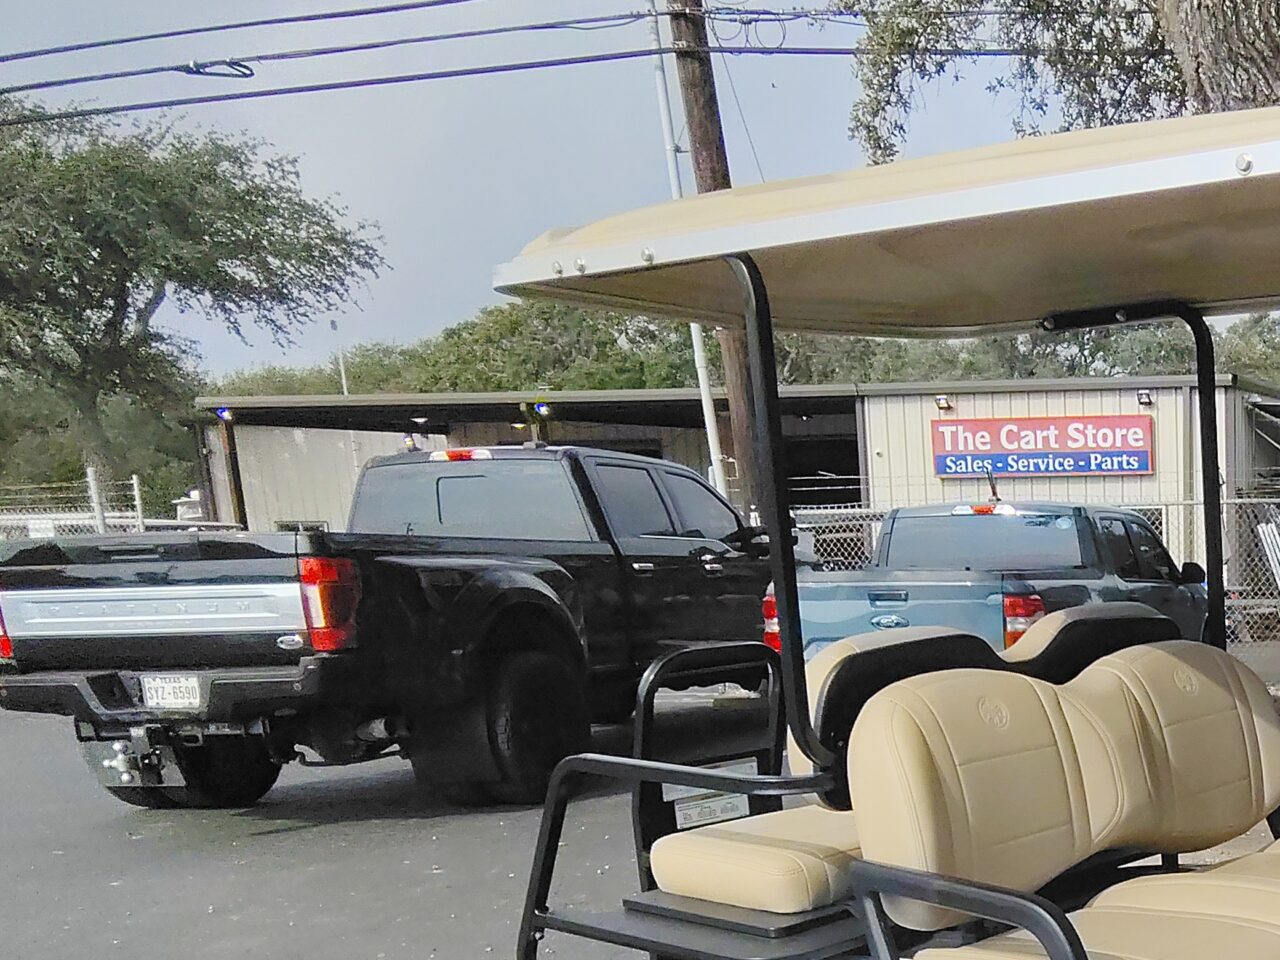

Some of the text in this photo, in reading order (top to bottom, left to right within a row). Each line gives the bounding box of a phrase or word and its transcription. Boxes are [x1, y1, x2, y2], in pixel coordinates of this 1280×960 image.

[938, 422, 1144, 450] The Cart Store
[945, 456, 993, 473] Sales
[1007, 454, 1074, 472] Service
[1089, 453, 1139, 470] Parts
